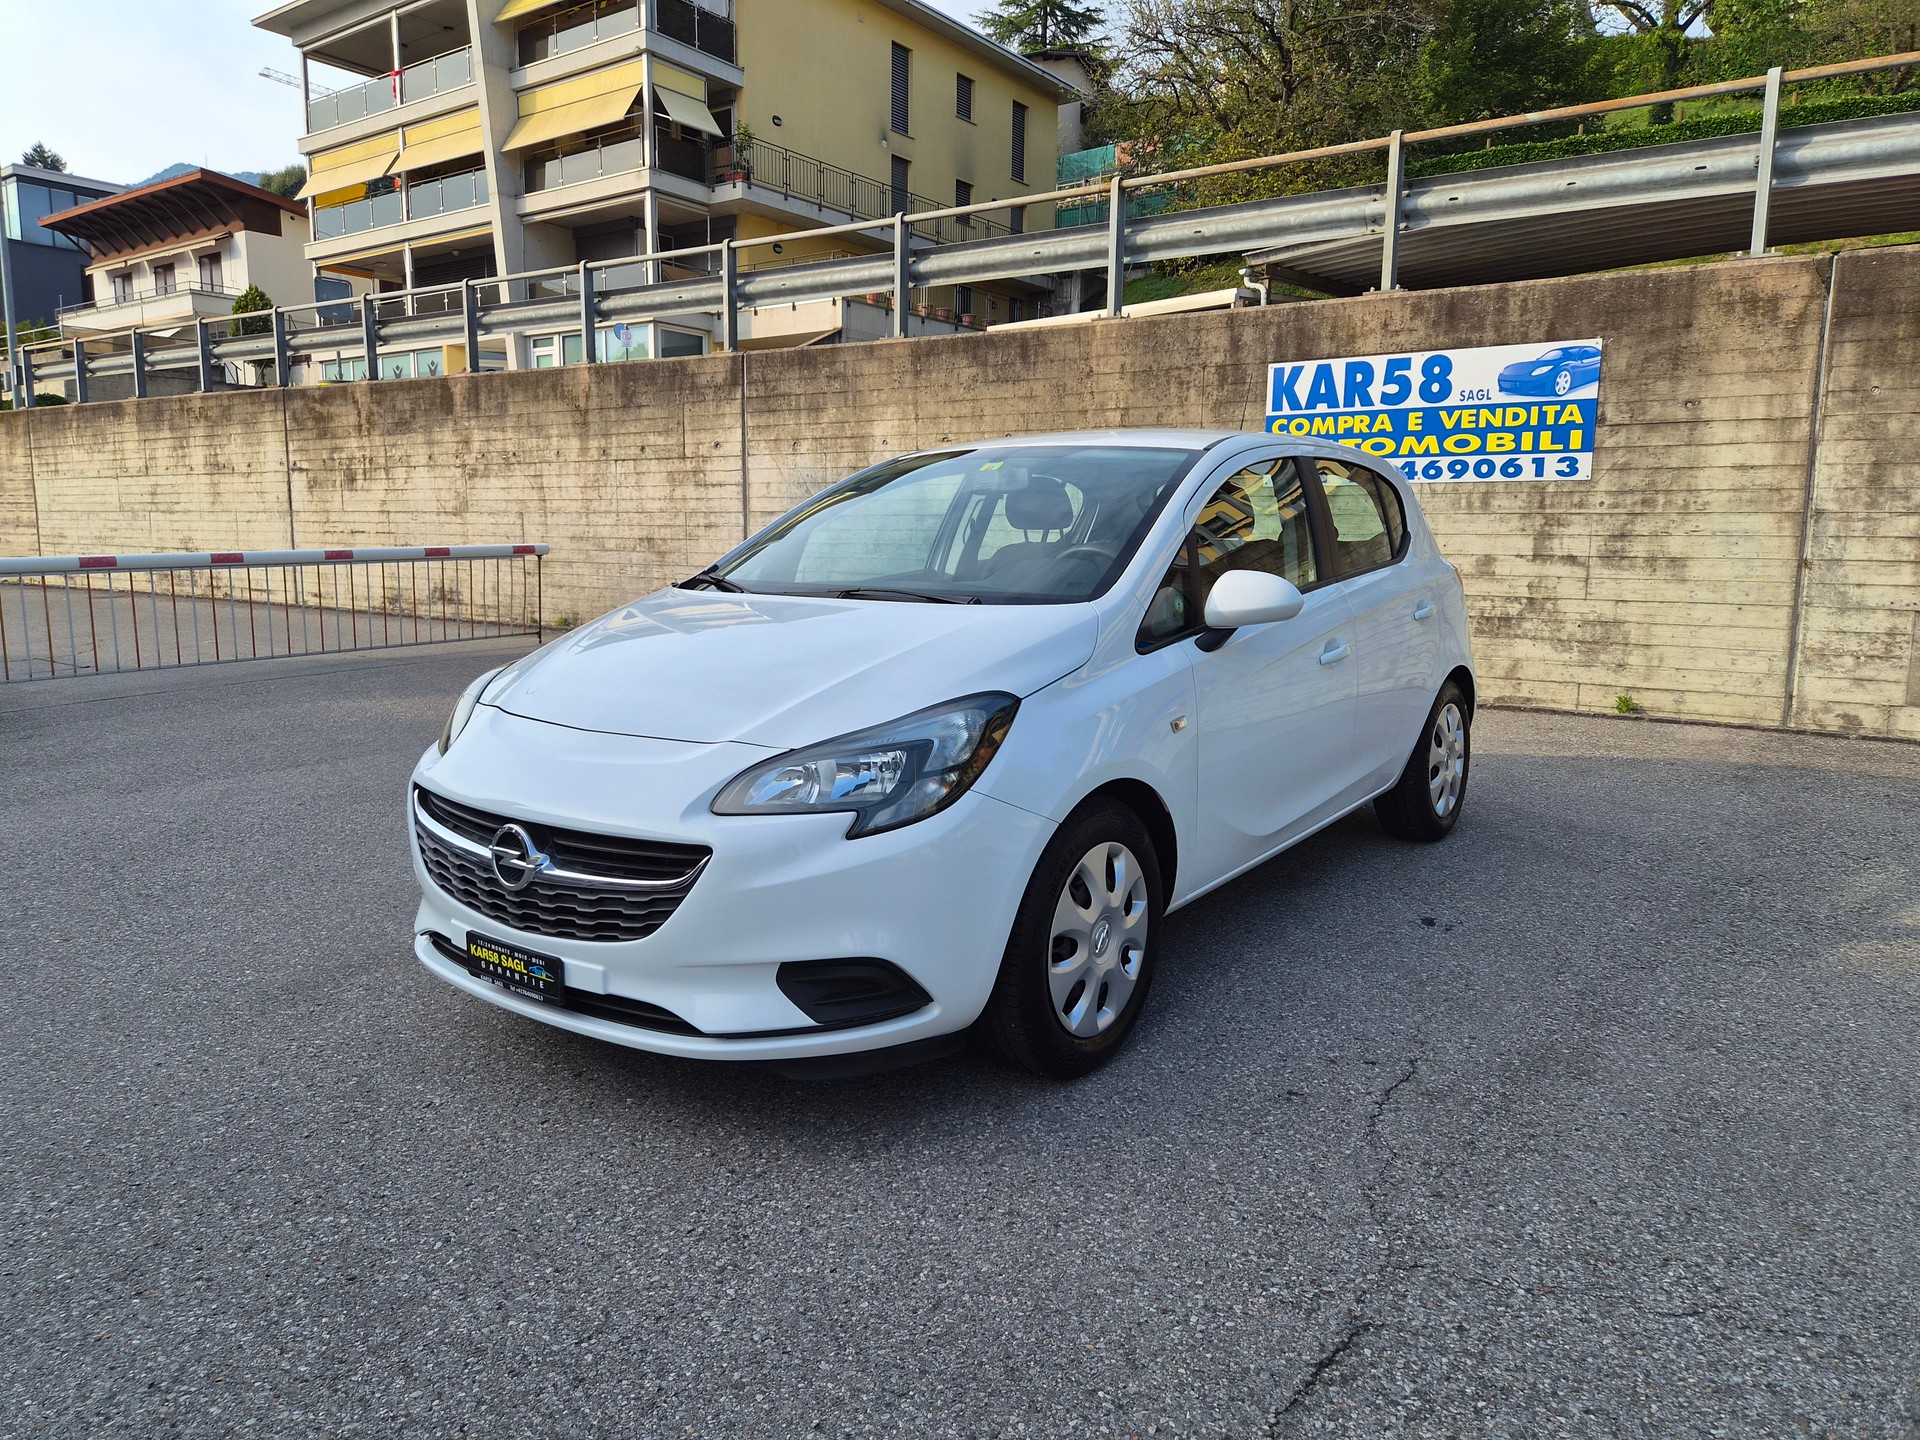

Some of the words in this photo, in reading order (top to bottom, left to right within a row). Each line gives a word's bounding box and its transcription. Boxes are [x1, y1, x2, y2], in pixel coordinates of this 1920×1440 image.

[1272, 354, 1453, 412] KAR58
[1459, 388, 1492, 402] SAGL
[1271, 414, 1394, 436] COMPRA
[1407, 411, 1424, 431] E
[1438, 403, 1584, 430] VENDITA
[1338, 429, 1584, 456] TOMOBILI
[1400, 456, 1580, 480] 4690613
[470, 943, 500, 964] KAR58
[501, 954, 528, 974] SAGL
[491, 944, 511, 955] MONATE
[481, 960, 544, 989] GARANTIE
